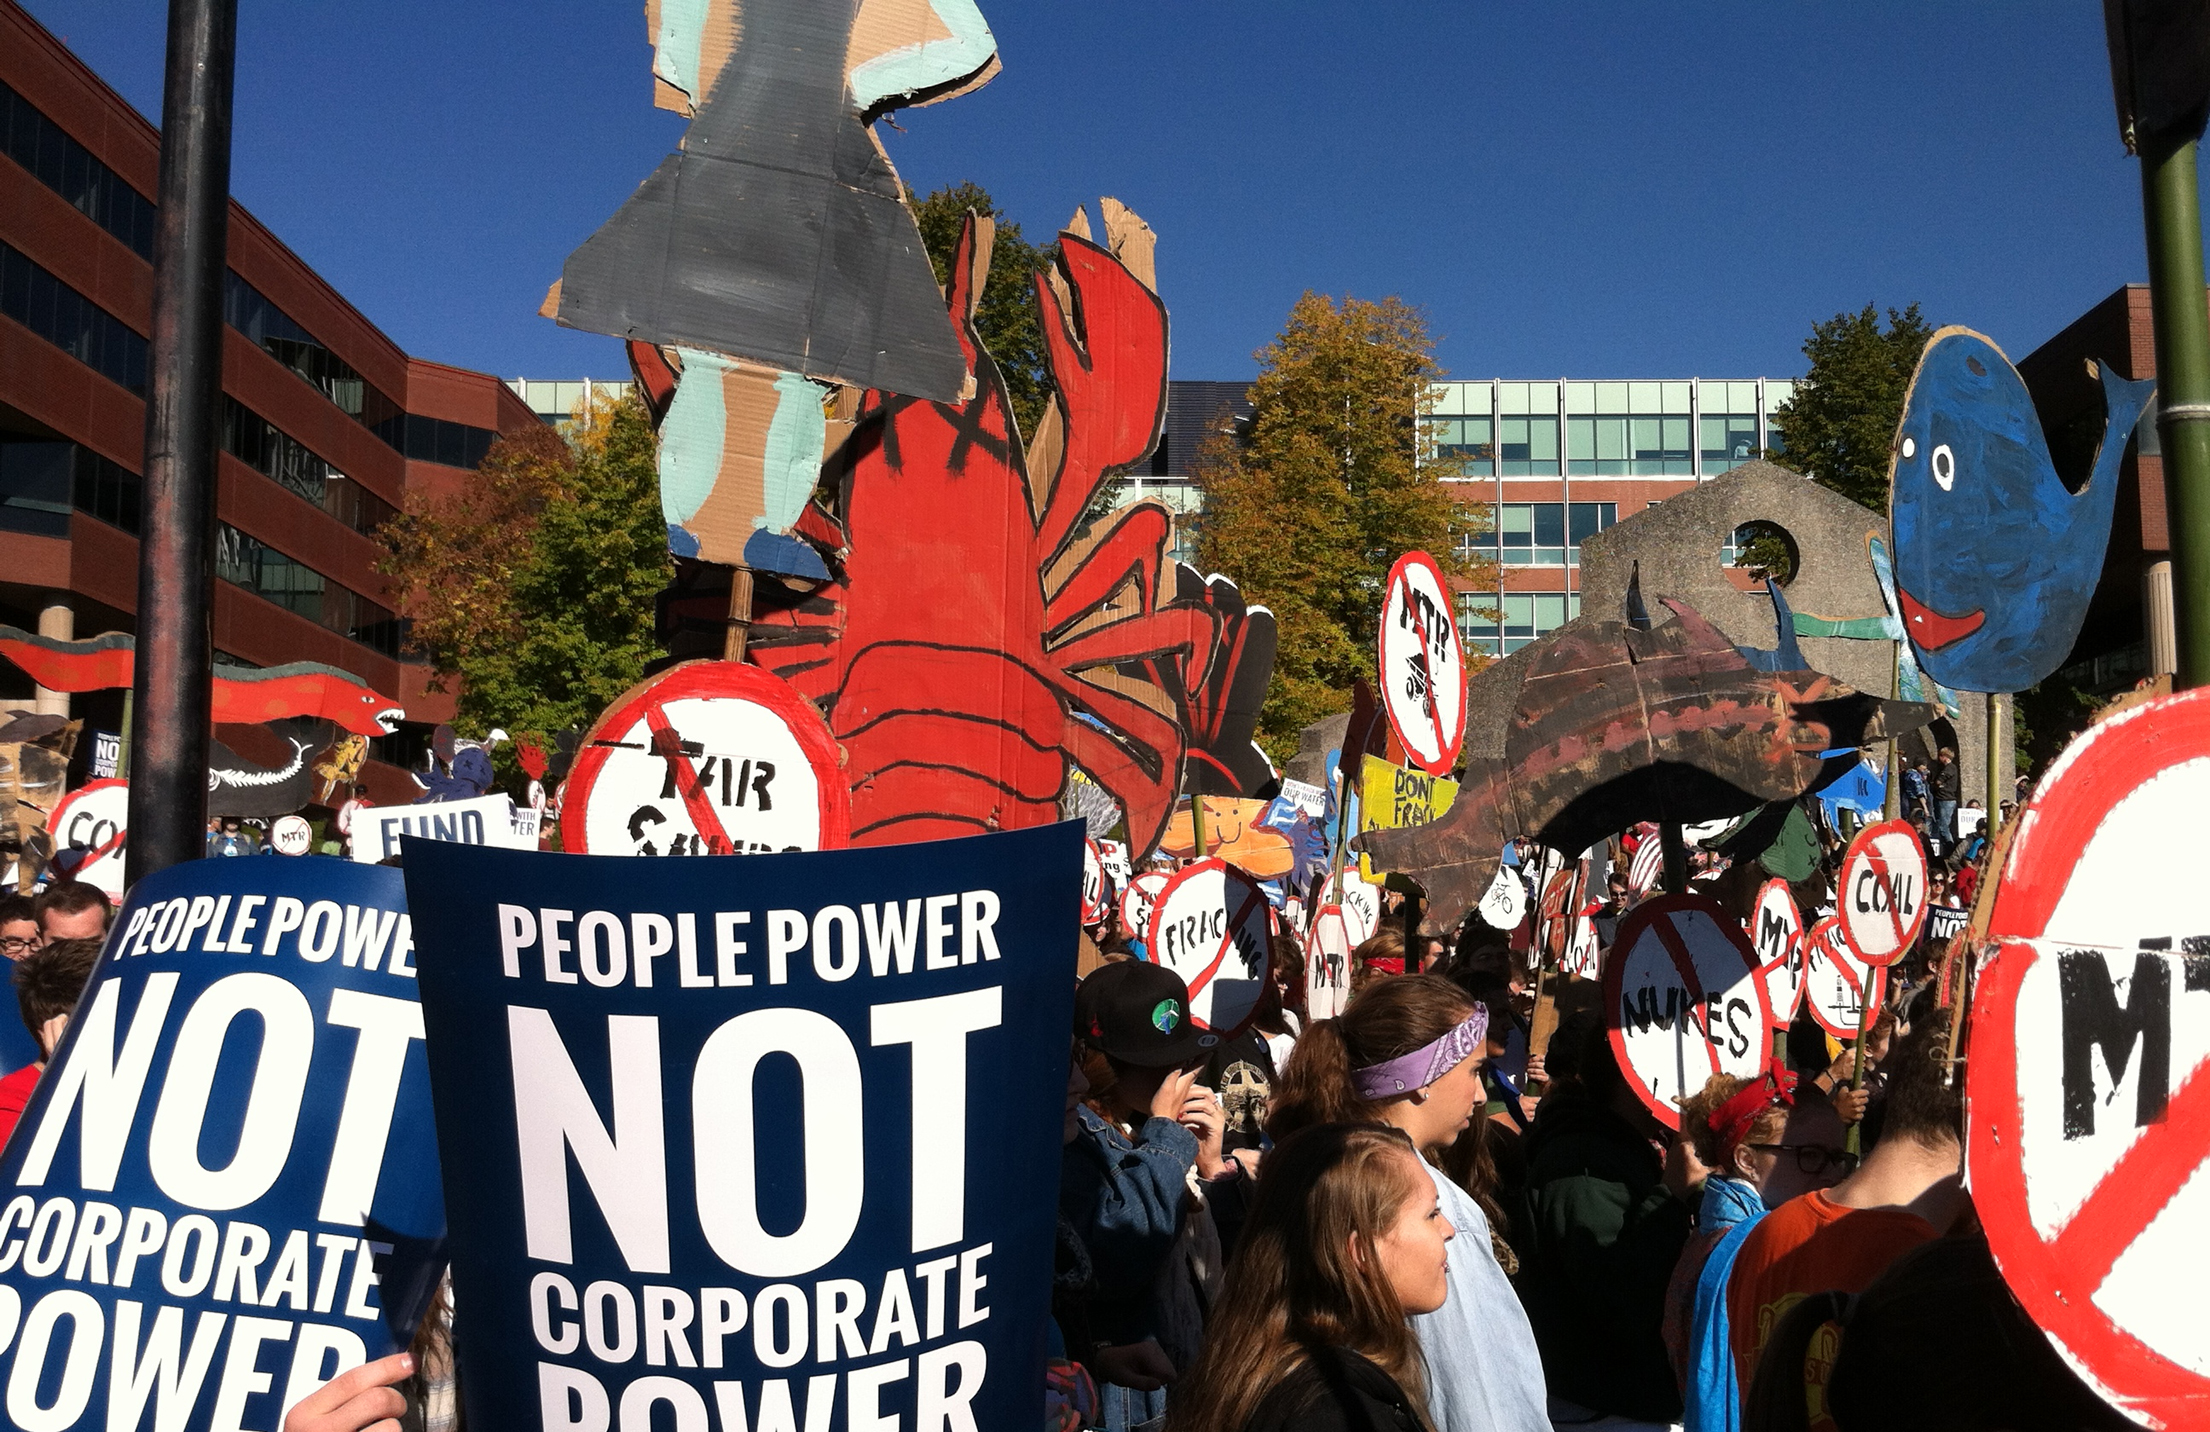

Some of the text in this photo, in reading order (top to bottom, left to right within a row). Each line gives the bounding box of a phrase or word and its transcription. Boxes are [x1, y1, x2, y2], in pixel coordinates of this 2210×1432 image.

[94, 764, 117, 778] POW
[96, 739, 120, 760] NO
[281, 829, 305, 843] MTR
[513, 821, 535, 836] TER
[1856, 869, 1913, 916] COAL
[114, 895, 418, 978] PEOPLE POWE
[498, 889, 1001, 988] PEOPLE POWER
[1314, 952, 1344, 989] MTR
[1623, 984, 1752, 1059] NUKES
[16, 971, 427, 1229] NOT
[507, 985, 1003, 1277] NOT
[0, 1194, 394, 1321] CORPORATE
[530, 1241, 993, 1368] CORPORATE
